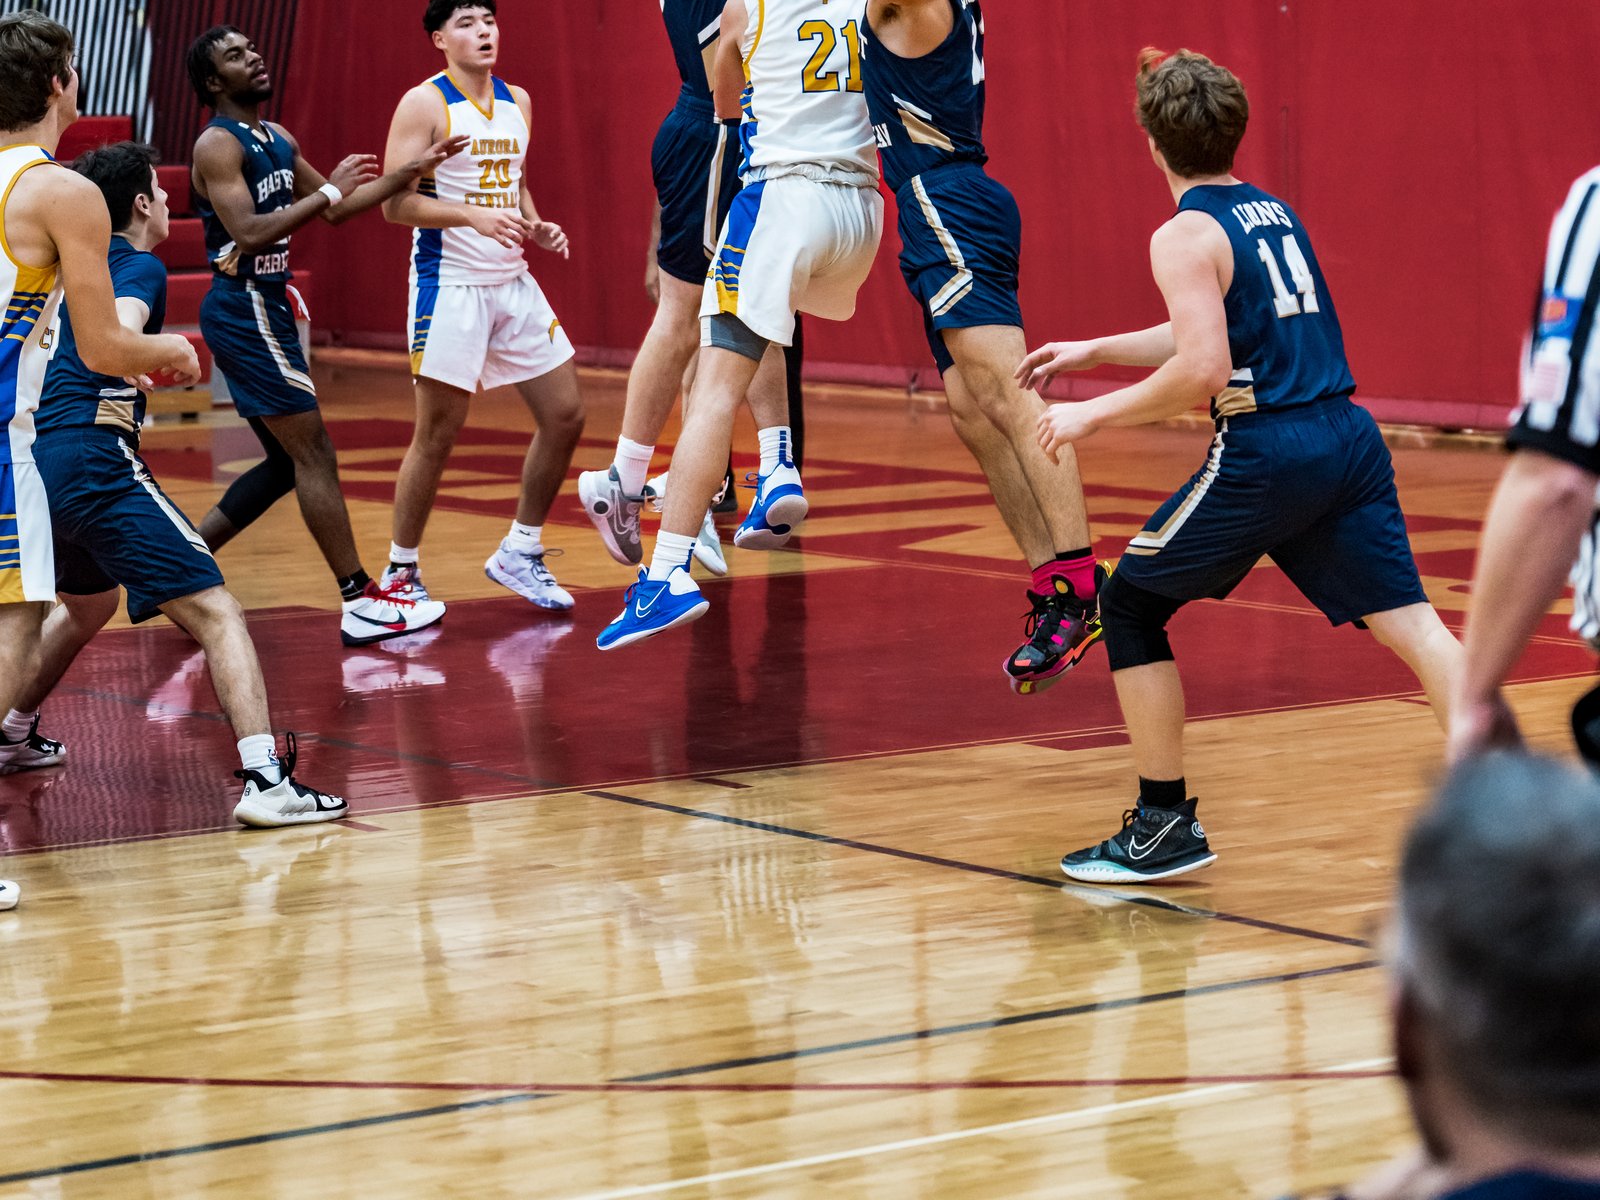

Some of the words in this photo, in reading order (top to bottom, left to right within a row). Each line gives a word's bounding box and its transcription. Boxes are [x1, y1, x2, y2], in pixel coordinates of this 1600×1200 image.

[797, 19, 864, 93] 21
[470, 138, 520, 156] AURORA
[478, 158, 512, 189] 20
[1231, 200, 1293, 235] LIONS
[1257, 234, 1320, 318] 14
